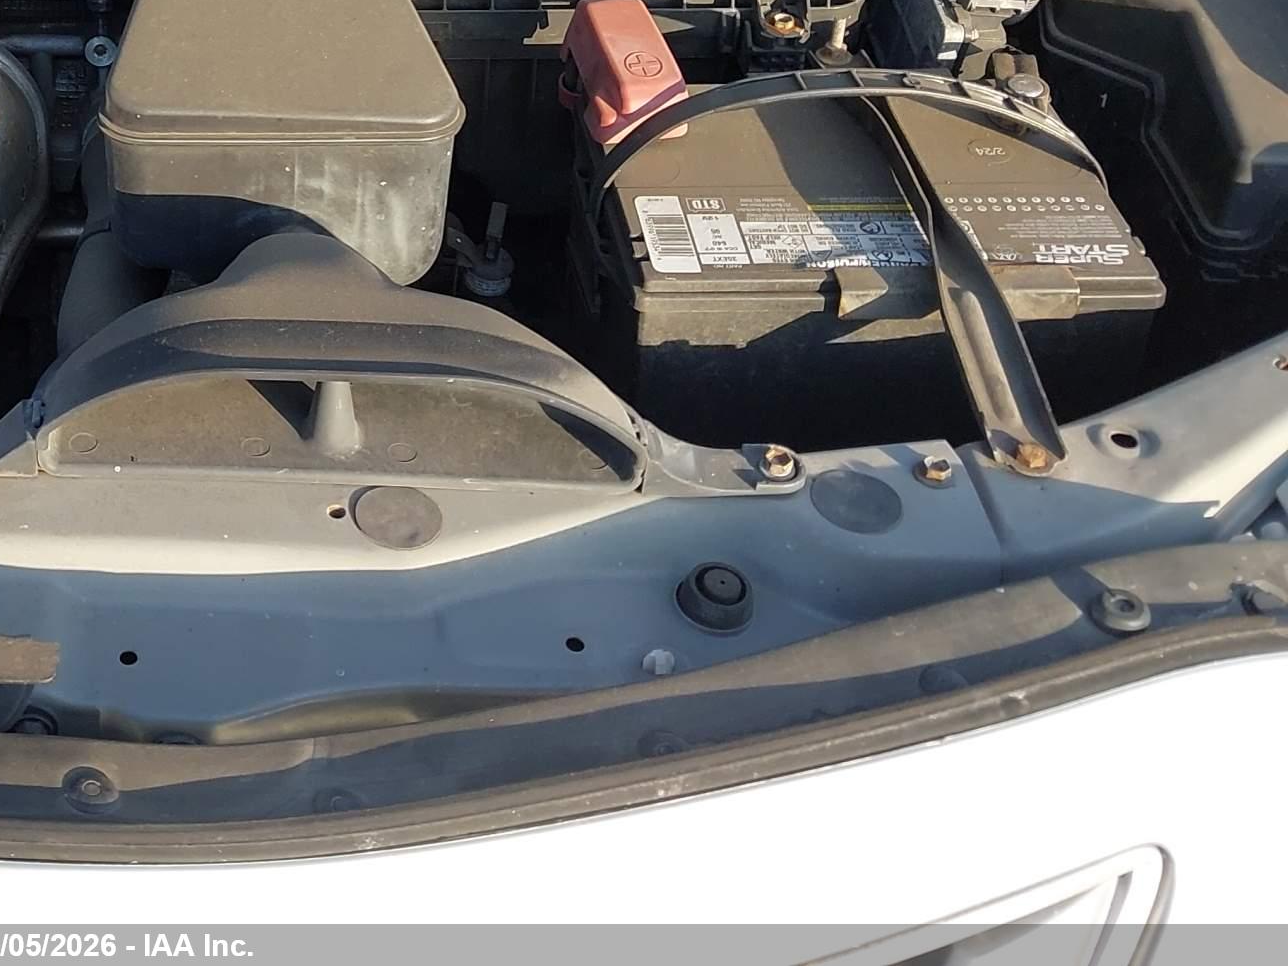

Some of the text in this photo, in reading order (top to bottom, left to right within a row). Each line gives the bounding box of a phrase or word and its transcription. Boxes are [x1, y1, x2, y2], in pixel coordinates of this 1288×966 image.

[691, 199, 721, 210] STD
[1034, 243, 1130, 257] START
[1035, 253, 1124, 265] SUPER
